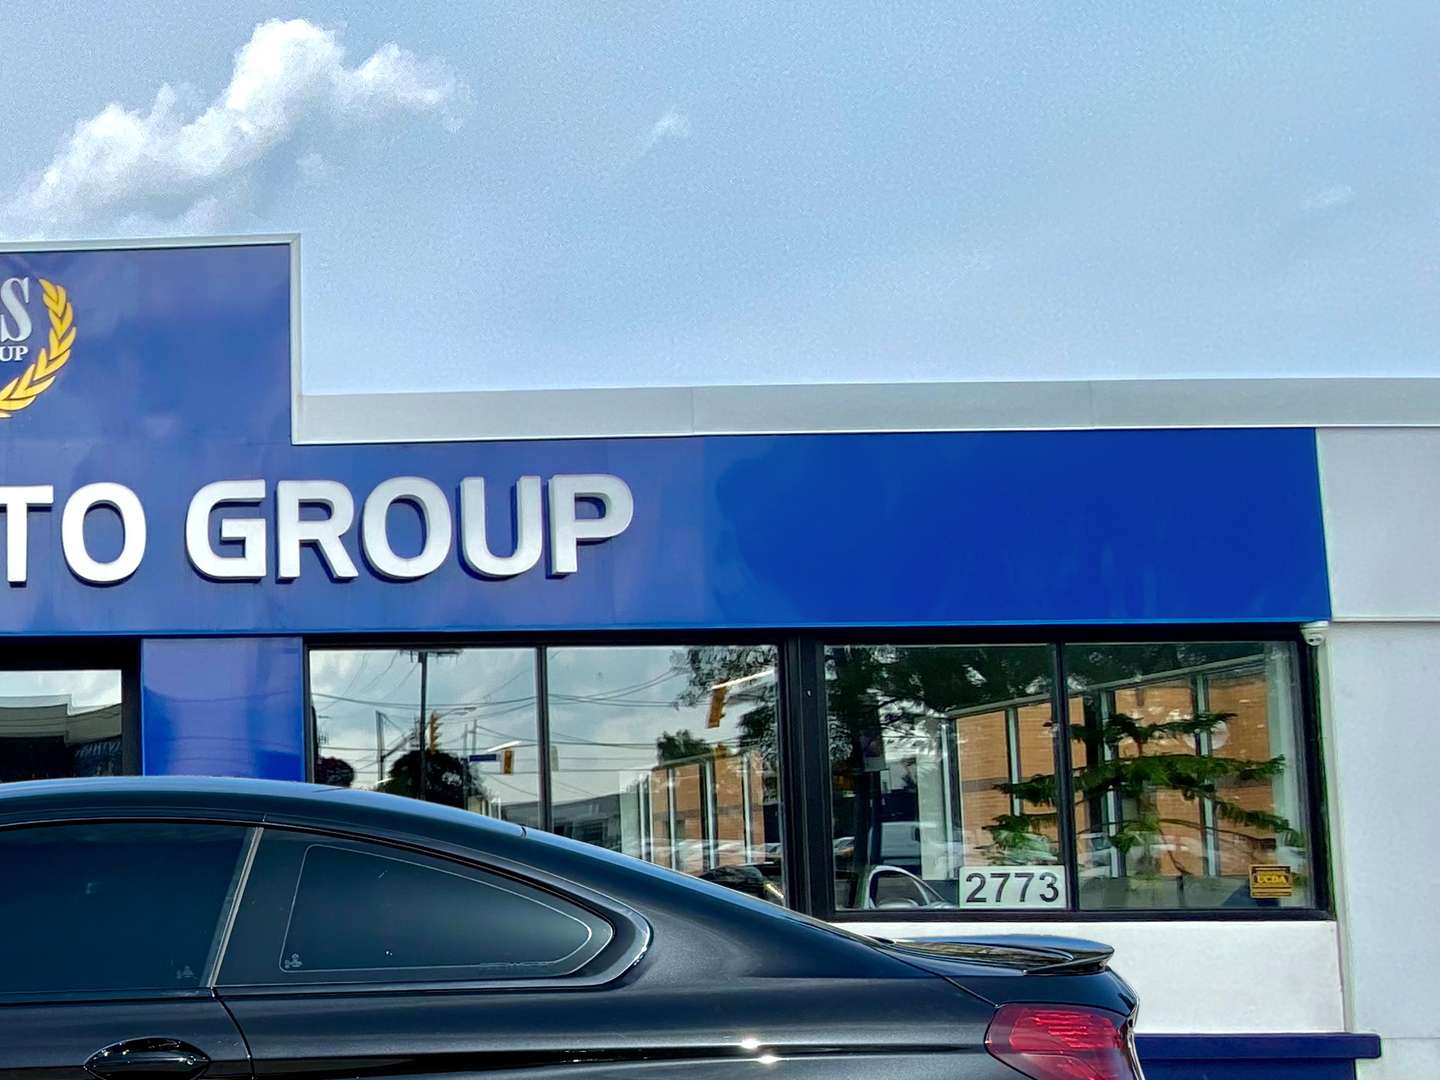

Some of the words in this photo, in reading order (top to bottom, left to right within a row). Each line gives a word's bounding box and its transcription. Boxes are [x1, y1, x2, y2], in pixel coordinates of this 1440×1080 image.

[184, 474, 635, 581] GROUP
[966, 872, 1060, 904] 2773
[1256, 874, 1288, 884] UCDA
